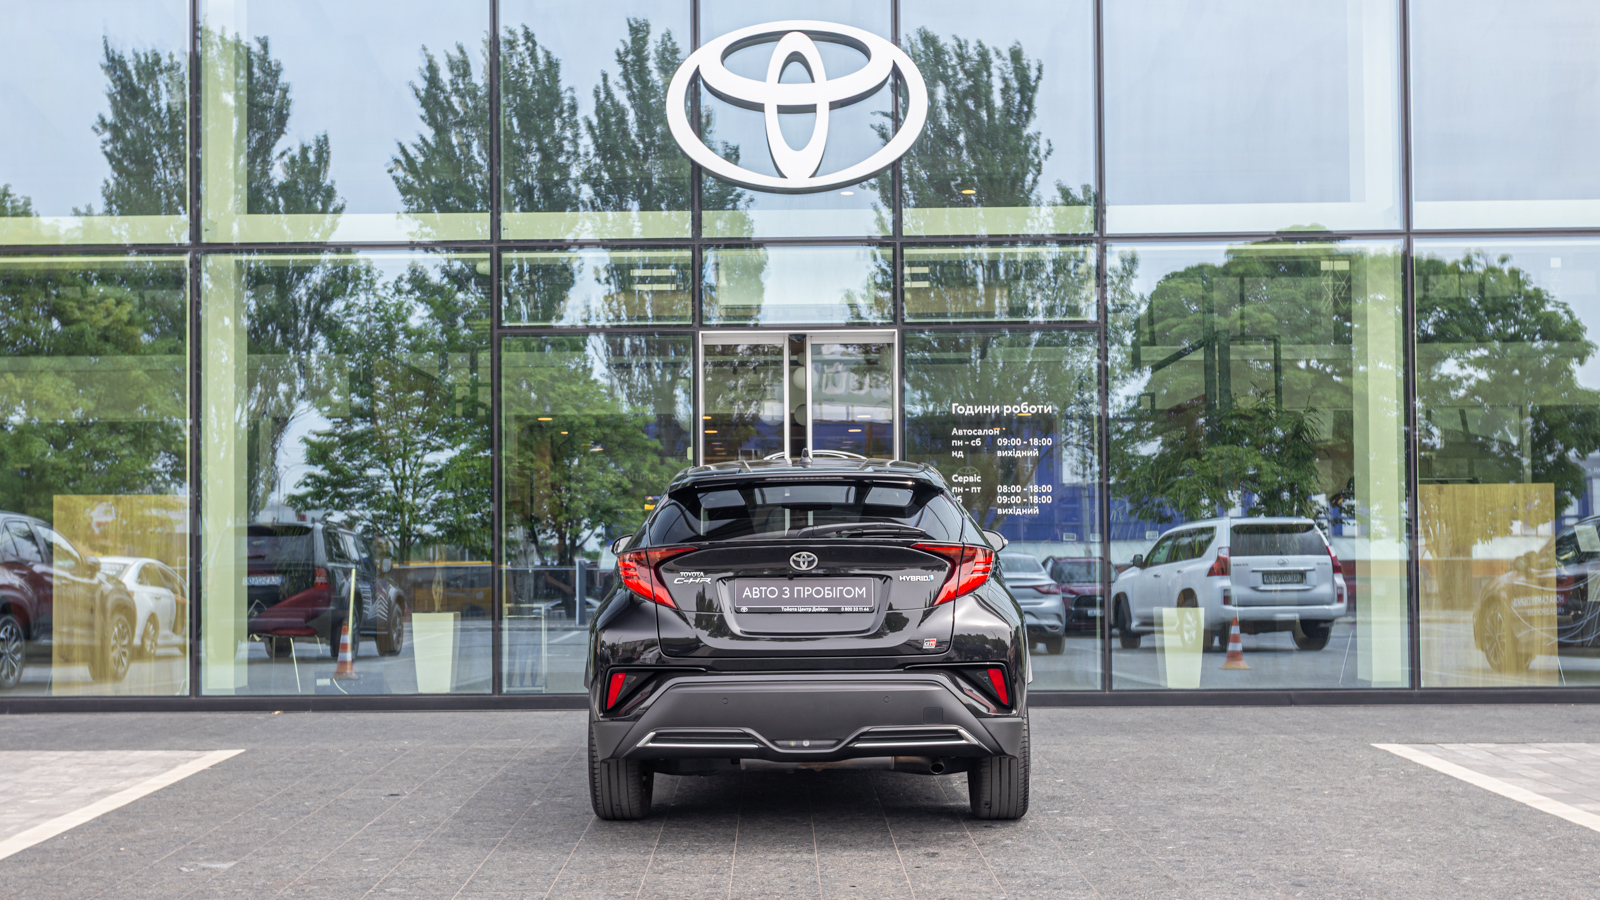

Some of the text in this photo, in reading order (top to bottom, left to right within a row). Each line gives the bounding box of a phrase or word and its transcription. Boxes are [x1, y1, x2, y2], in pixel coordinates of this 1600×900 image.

[952, 402, 1053, 416] Години роботи
[952, 427, 1000, 436] Автосалон
[971, 438, 981, 446] сб
[997, 438, 1022, 446] 09:00
[1029, 438, 1053, 446] 18:00
[952, 450, 964, 458] нд
[997, 448, 1039, 458] вихідний
[952, 474, 982, 484] Сервіс
[997, 485, 1022, 493] 08:00
[1029, 485, 1053, 493] 18:00
[997, 496, 1022, 504] 09:00
[1029, 496, 1053, 504] 18:00
[997, 506, 1040, 516] вихідний
[742, 586, 867, 599] АВТО З ПРОБІГОМ
